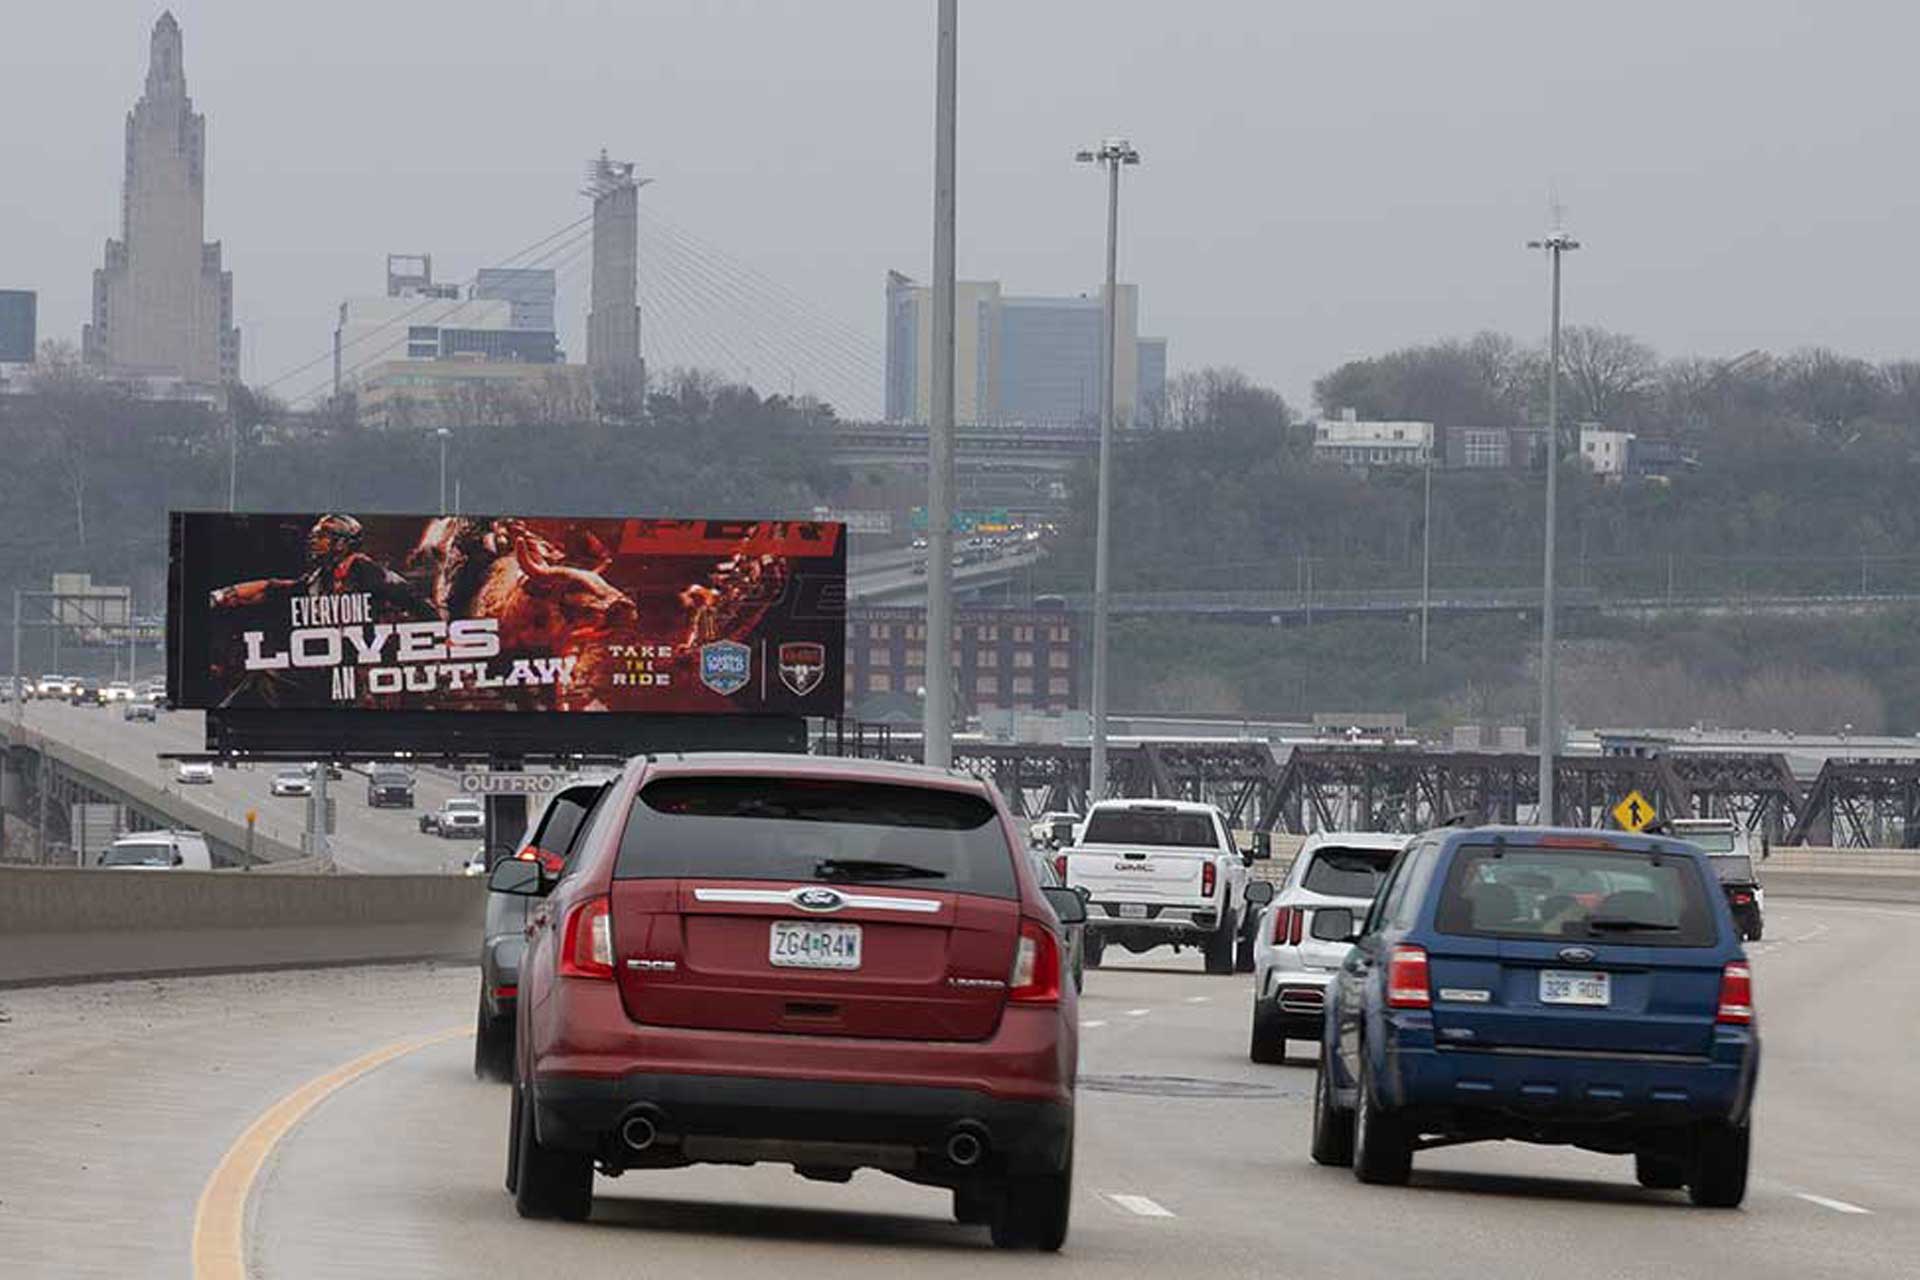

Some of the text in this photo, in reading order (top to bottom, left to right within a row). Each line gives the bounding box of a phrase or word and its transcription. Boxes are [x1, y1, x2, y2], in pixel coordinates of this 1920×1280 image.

[291, 592, 373, 627] EVERYONE
[243, 618, 501, 671] LOVES
[608, 645, 673, 658] TAKE
[626, 660, 654, 671] THE
[332, 656, 577, 701] AN OUTLAW
[613, 673, 671, 686] RIDE
